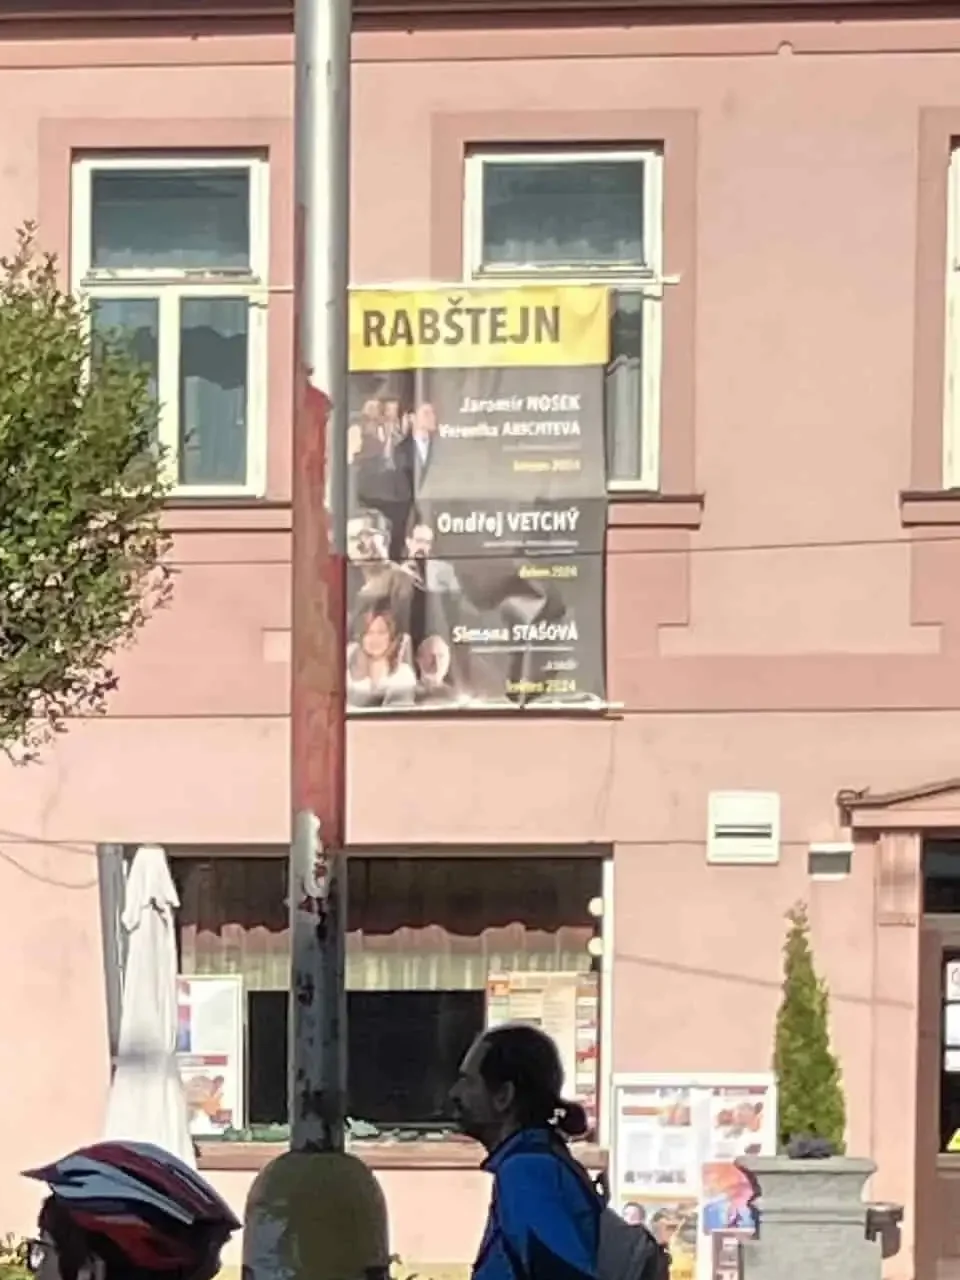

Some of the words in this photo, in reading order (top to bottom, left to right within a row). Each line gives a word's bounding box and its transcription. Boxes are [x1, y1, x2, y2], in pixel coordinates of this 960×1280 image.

[362, 297, 561, 348] RABŠTEJN
[526, 394, 581, 412] NOSEK
[437, 511, 503, 537] Ondřej
[506, 506, 580, 532] VETCHÝ
[512, 620, 579, 641] STAŠOVÁ
